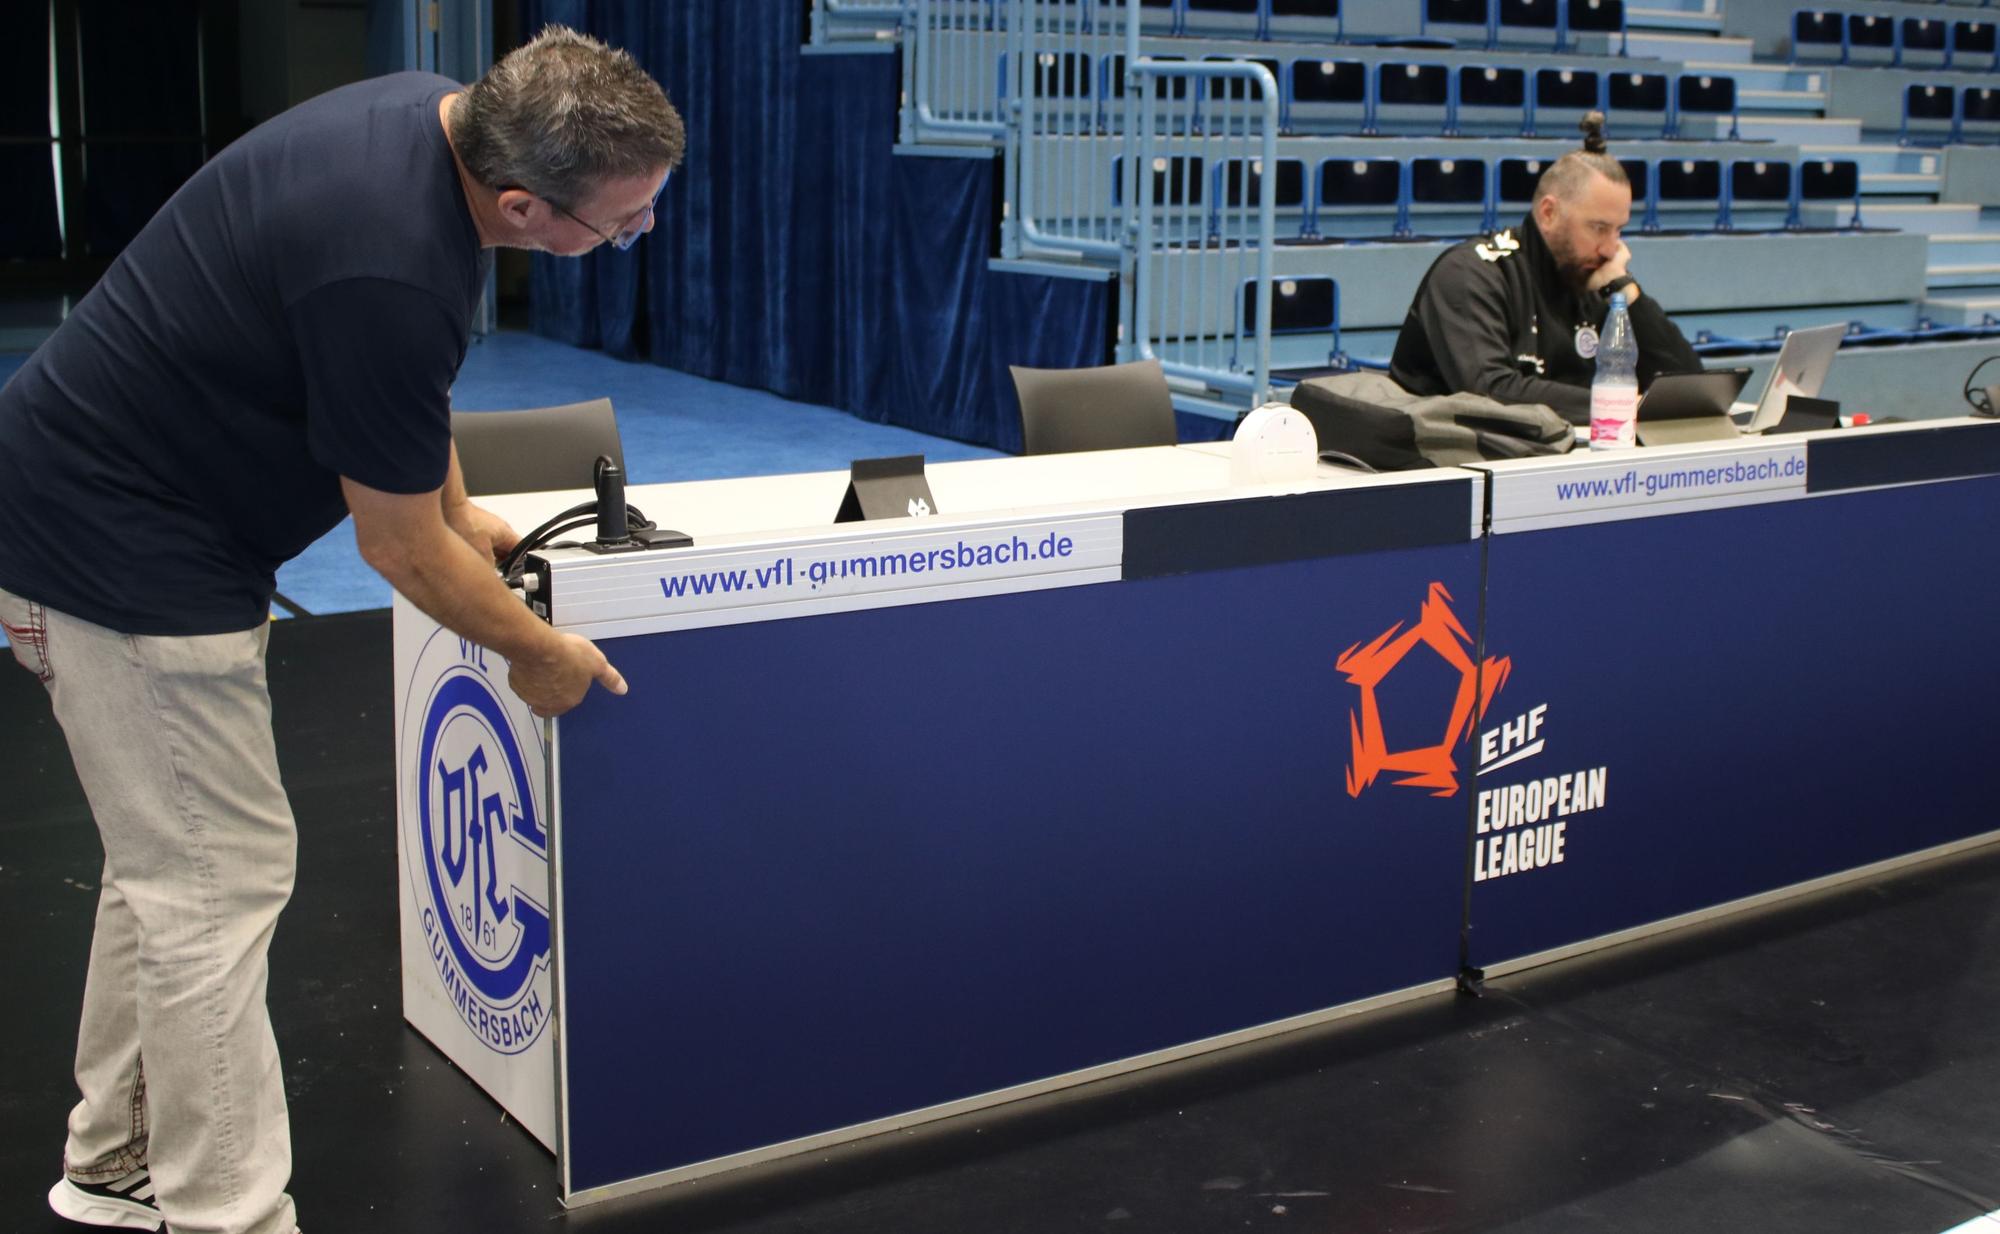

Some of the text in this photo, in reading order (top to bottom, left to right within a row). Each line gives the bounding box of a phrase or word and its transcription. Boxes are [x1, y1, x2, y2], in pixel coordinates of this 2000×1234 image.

[1557, 456, 1805, 500] www.vfl-gummersbach.de
[1480, 703, 1547, 766] EHF
[1477, 767, 1606, 834] EUROPEAN
[1474, 821, 1566, 882] LEAGUE
[424, 907, 543, 1047] GUMMERSBACH
